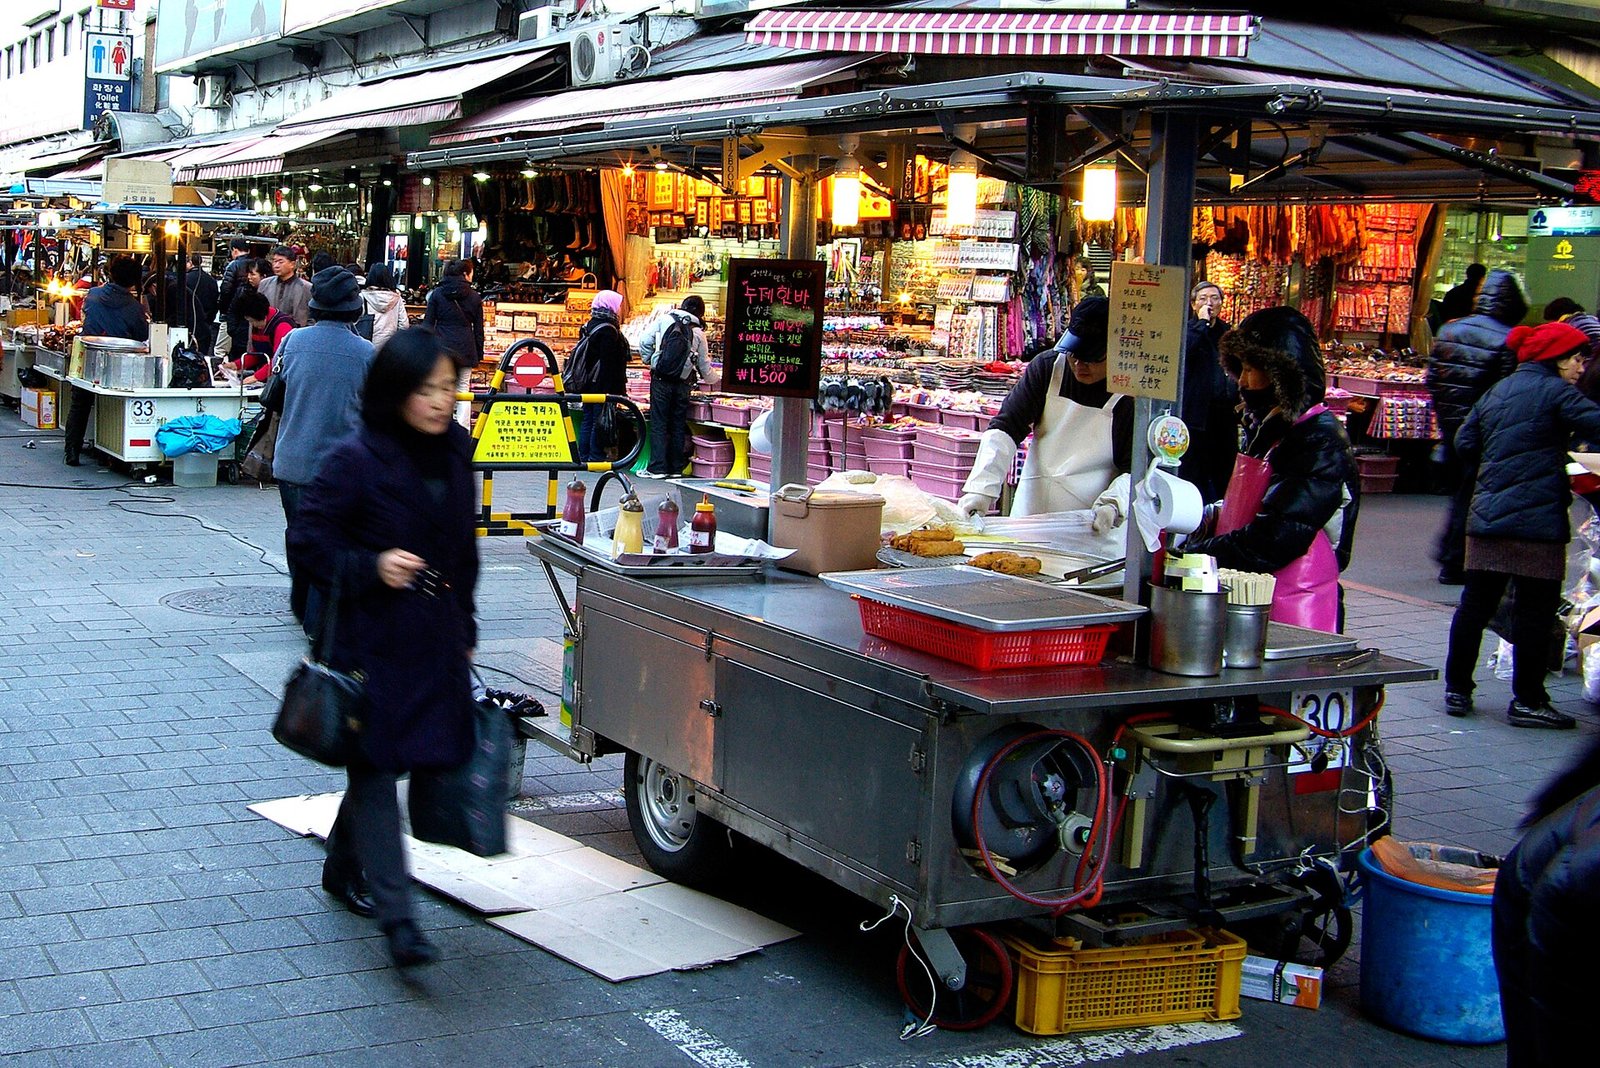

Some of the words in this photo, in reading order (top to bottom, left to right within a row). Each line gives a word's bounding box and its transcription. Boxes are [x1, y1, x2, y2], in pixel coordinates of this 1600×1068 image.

[92, 84, 124, 93] 화장실
[96, 93, 119, 102] Toilet
[133, 400, 154, 417] 33
[504, 405, 527, 416] 차없는
[532, 405, 547, 416] 거리
[1301, 691, 1345, 740] 30
[1273, 973, 1281, 1002] ECONOMY
